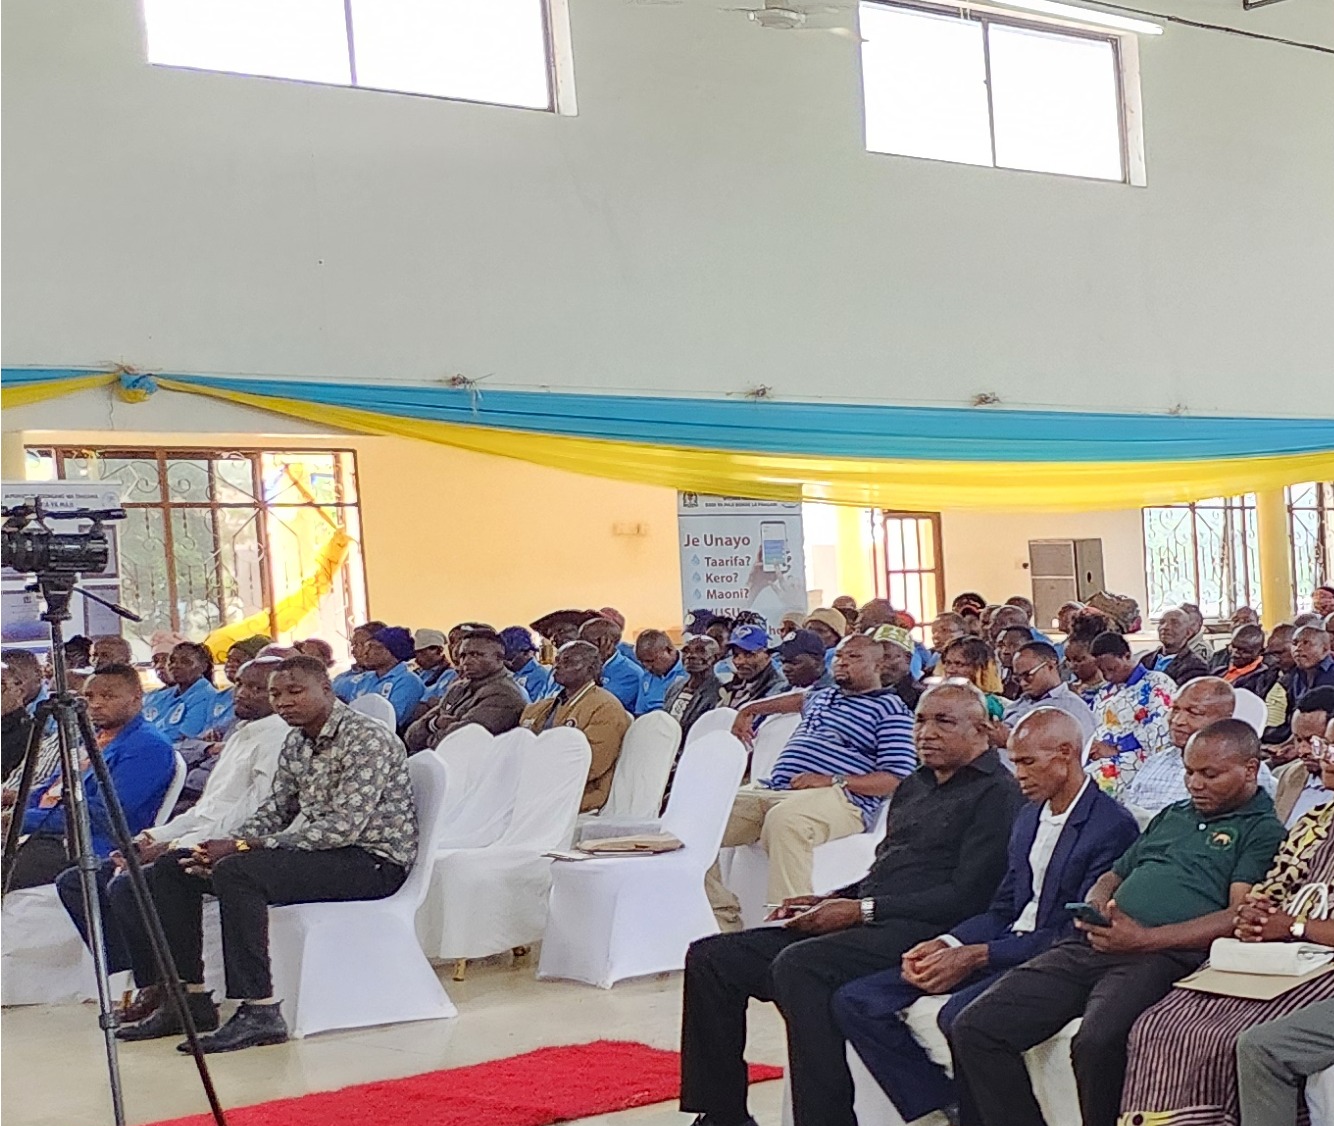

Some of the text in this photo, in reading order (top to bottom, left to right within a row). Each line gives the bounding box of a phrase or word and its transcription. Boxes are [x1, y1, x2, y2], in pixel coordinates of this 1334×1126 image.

[684, 534, 751, 549] Je Unayo
[704, 556, 751, 567] Taarifa?
[705, 573, 739, 583] Kero?
[706, 589, 750, 600] Maoni?
